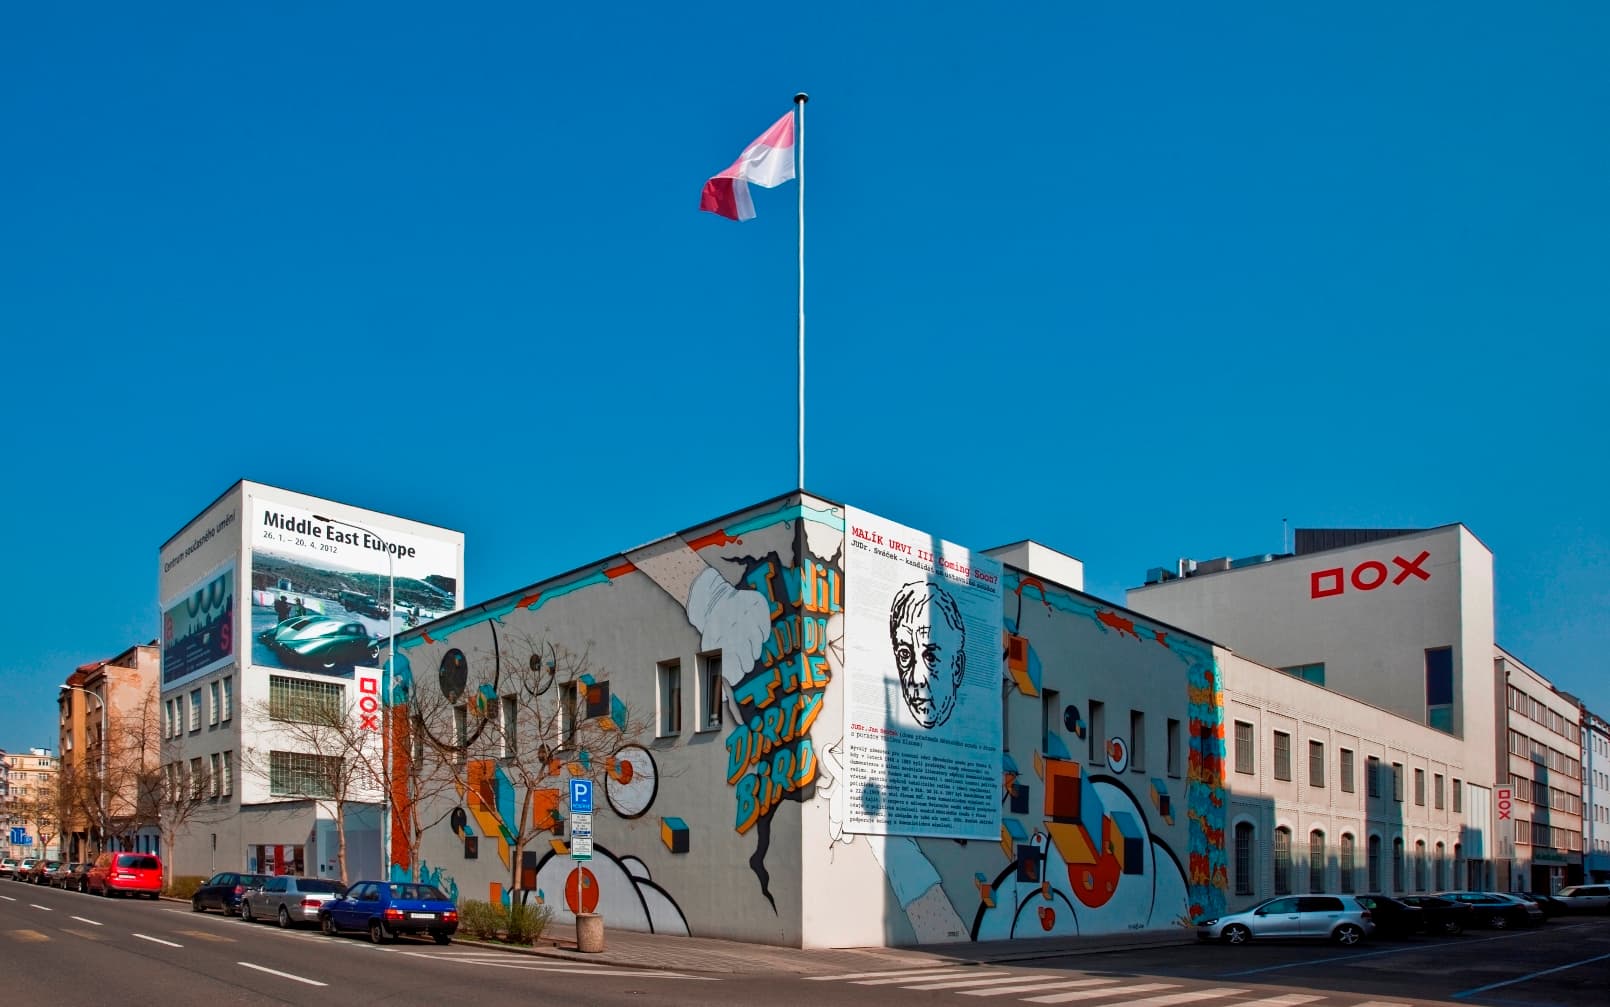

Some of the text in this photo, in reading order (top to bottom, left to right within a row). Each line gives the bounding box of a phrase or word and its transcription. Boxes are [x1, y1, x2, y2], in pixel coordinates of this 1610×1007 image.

[263, 510, 416, 559] Middle East Europe
[263, 531, 275, 540] 26.
[279, 534, 286, 543] 1.
[295, 537, 308, 548] 20.
[310, 542, 317, 550] 4.
[320, 543, 338, 554] 2012
[851, 526, 998, 585] MALÍK URVI III Coming Soon?
[734, 652, 832, 709] THE
[574, 783, 588, 802] P
